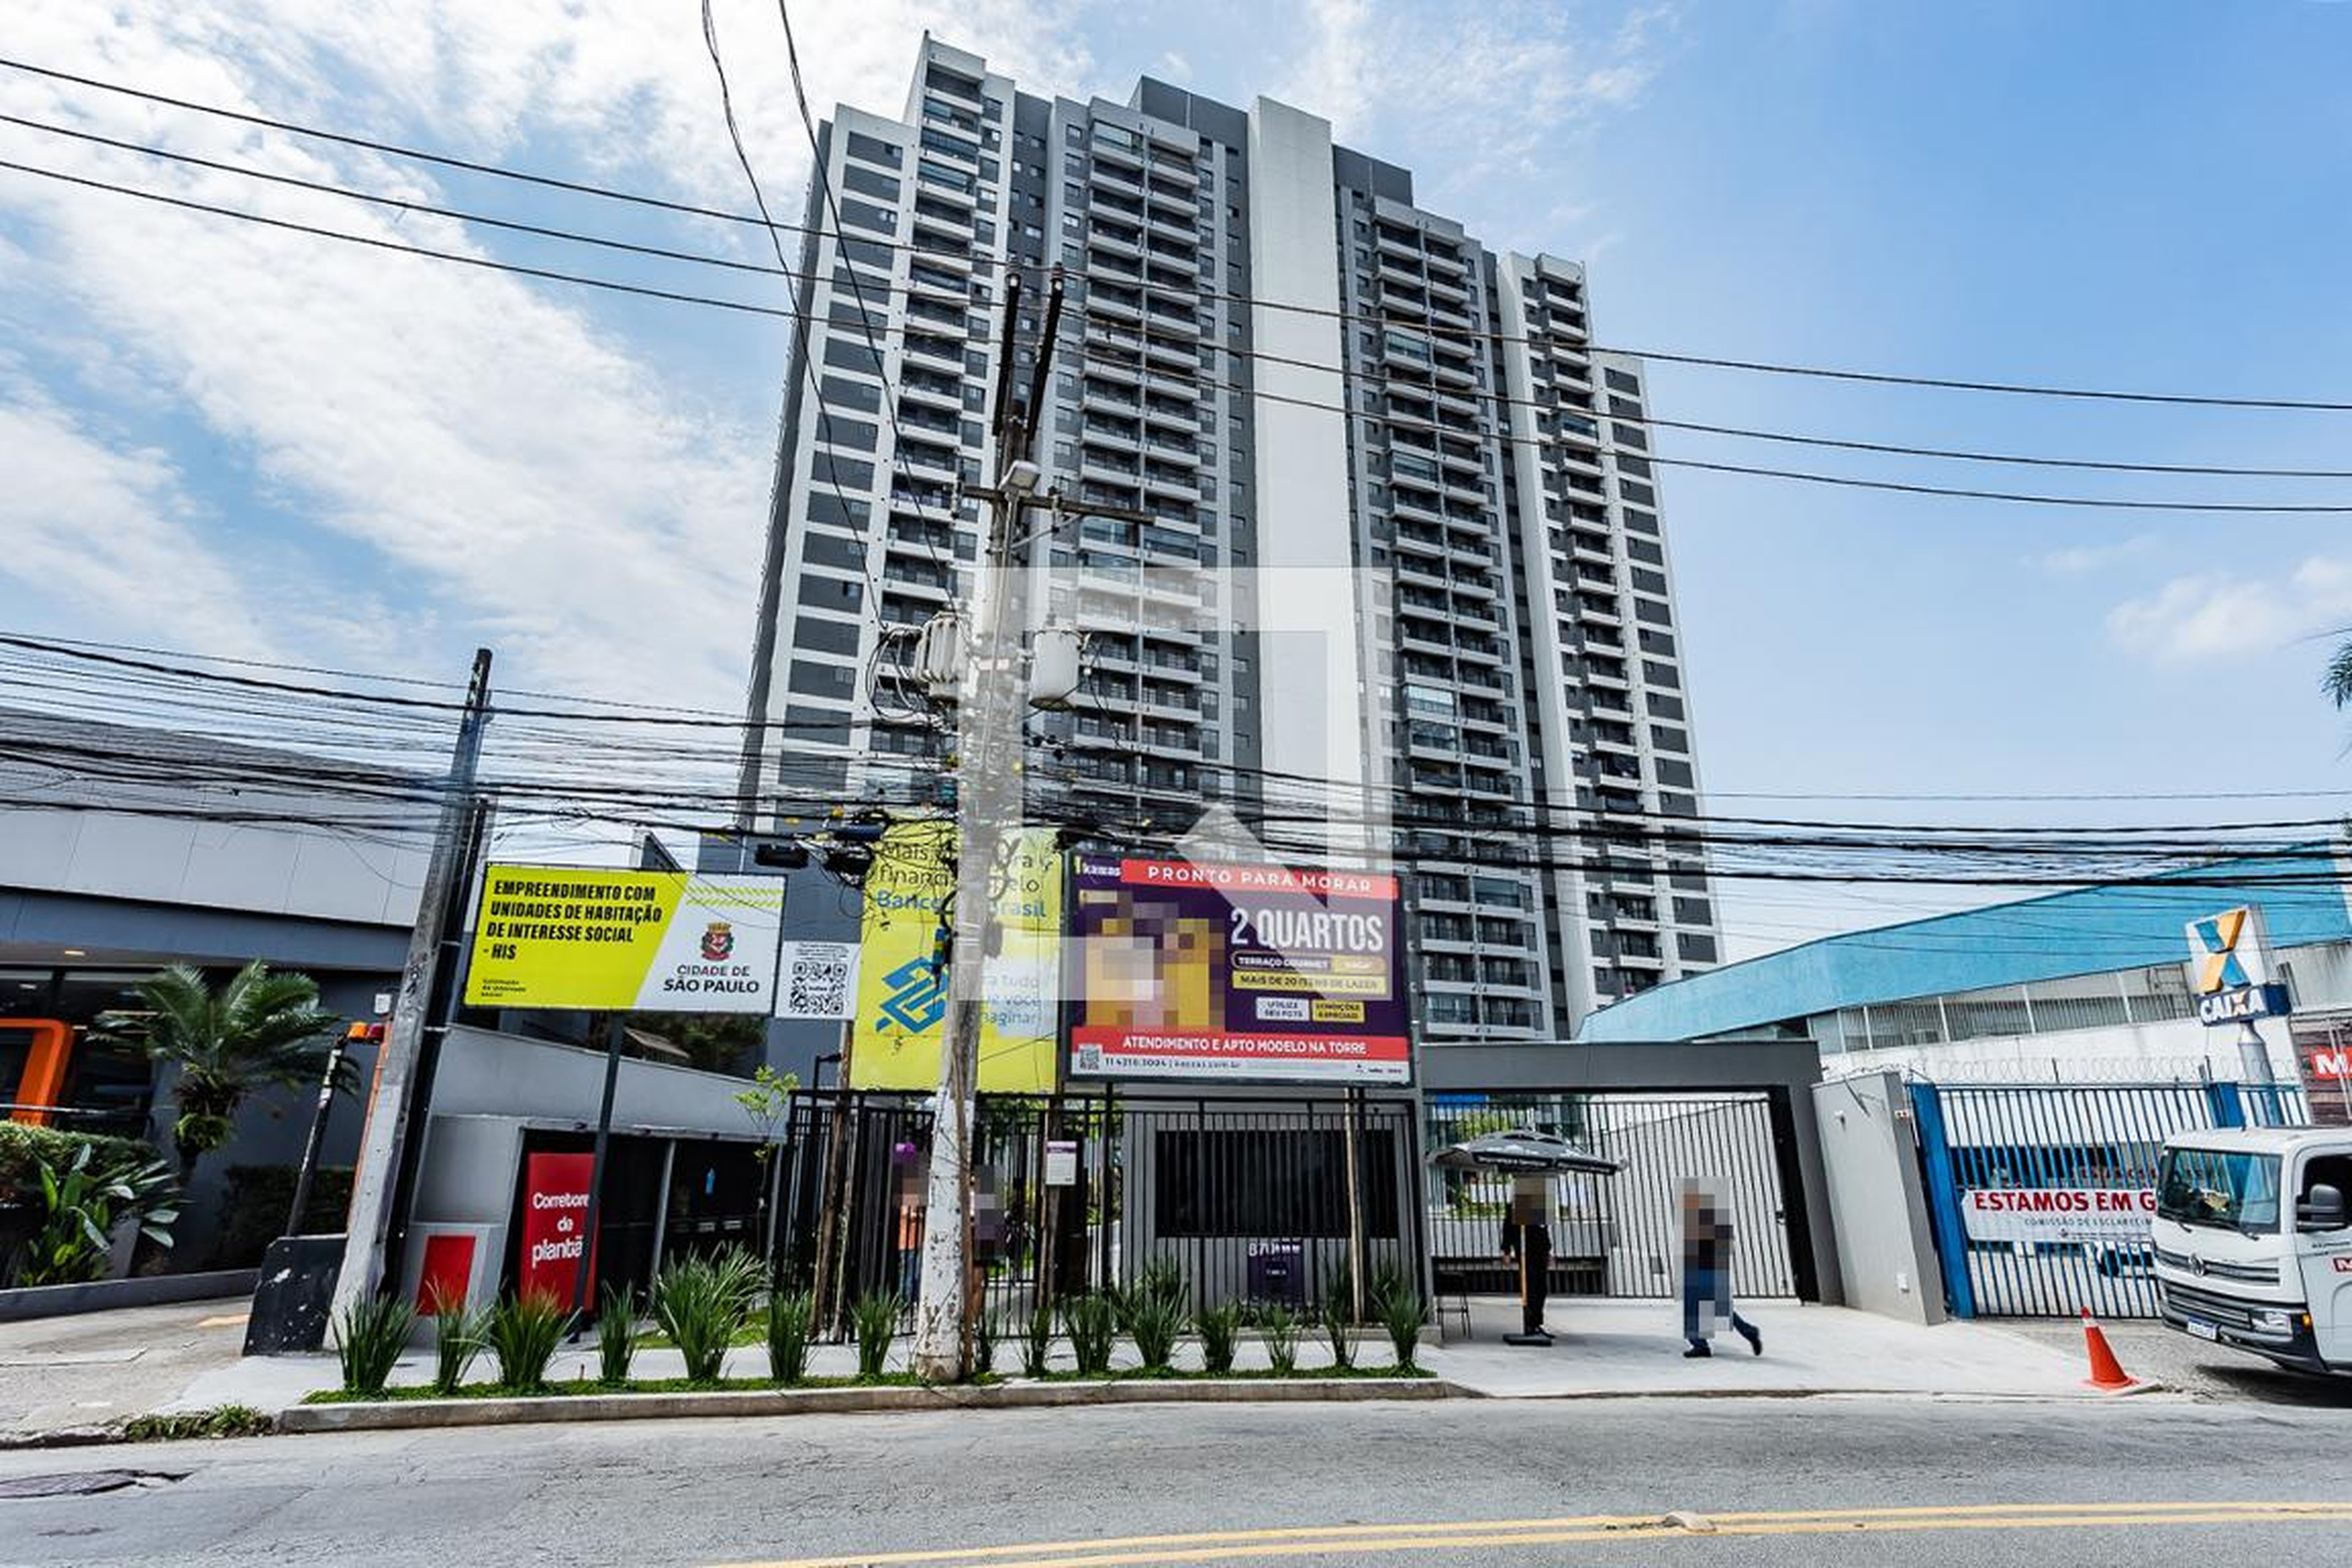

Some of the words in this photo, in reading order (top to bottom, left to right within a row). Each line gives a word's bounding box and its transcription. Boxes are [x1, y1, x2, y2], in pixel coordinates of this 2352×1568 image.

[1148, 865, 1232, 883] PRONTO
[1241, 871, 1294, 887] PARA
[1302, 874, 1371, 891] MORAR
[494, 880, 622, 900] EMPREENDIMENTO
[624, 886, 656, 902] COM
[491, 901, 562, 919] UNIDADES
[565, 904, 585, 920] DE
[585, 905, 662, 925] HABITAÇÃO
[486, 922, 505, 938] DE
[508, 923, 582, 941] INTERESSE
[585, 927, 635, 943] SOCIAL
[1231, 907, 1249, 944] 2
[1257, 909, 1384, 951] QUARTOS
[492, 944, 517, 960] HIS
[1238, 956, 1283, 968] TERRAÇO
[677, 964, 727, 976] CIDADE
[733, 966, 750, 977] DE
[1240, 975, 1267, 984] MAIS
[663, 975, 699, 992] SÃO
[704, 979, 760, 993] PAULO
[2200, 989, 2266, 1023] CAIXA
[1123, 1035, 1210, 1050] ATENDIMENTO
[1212, 1038, 1220, 1050] E
[1223, 1039, 1254, 1052] APTO
[1257, 1039, 1306, 1053] MODELO
[1309, 1041, 1326, 1054] NA
[1329, 1042, 1368, 1055] TORRE
[1973, 1192, 2089, 1212] ESTAMOS
[2096, 1192, 2133, 1212] EM
[532, 1235, 584, 1269] plantã
